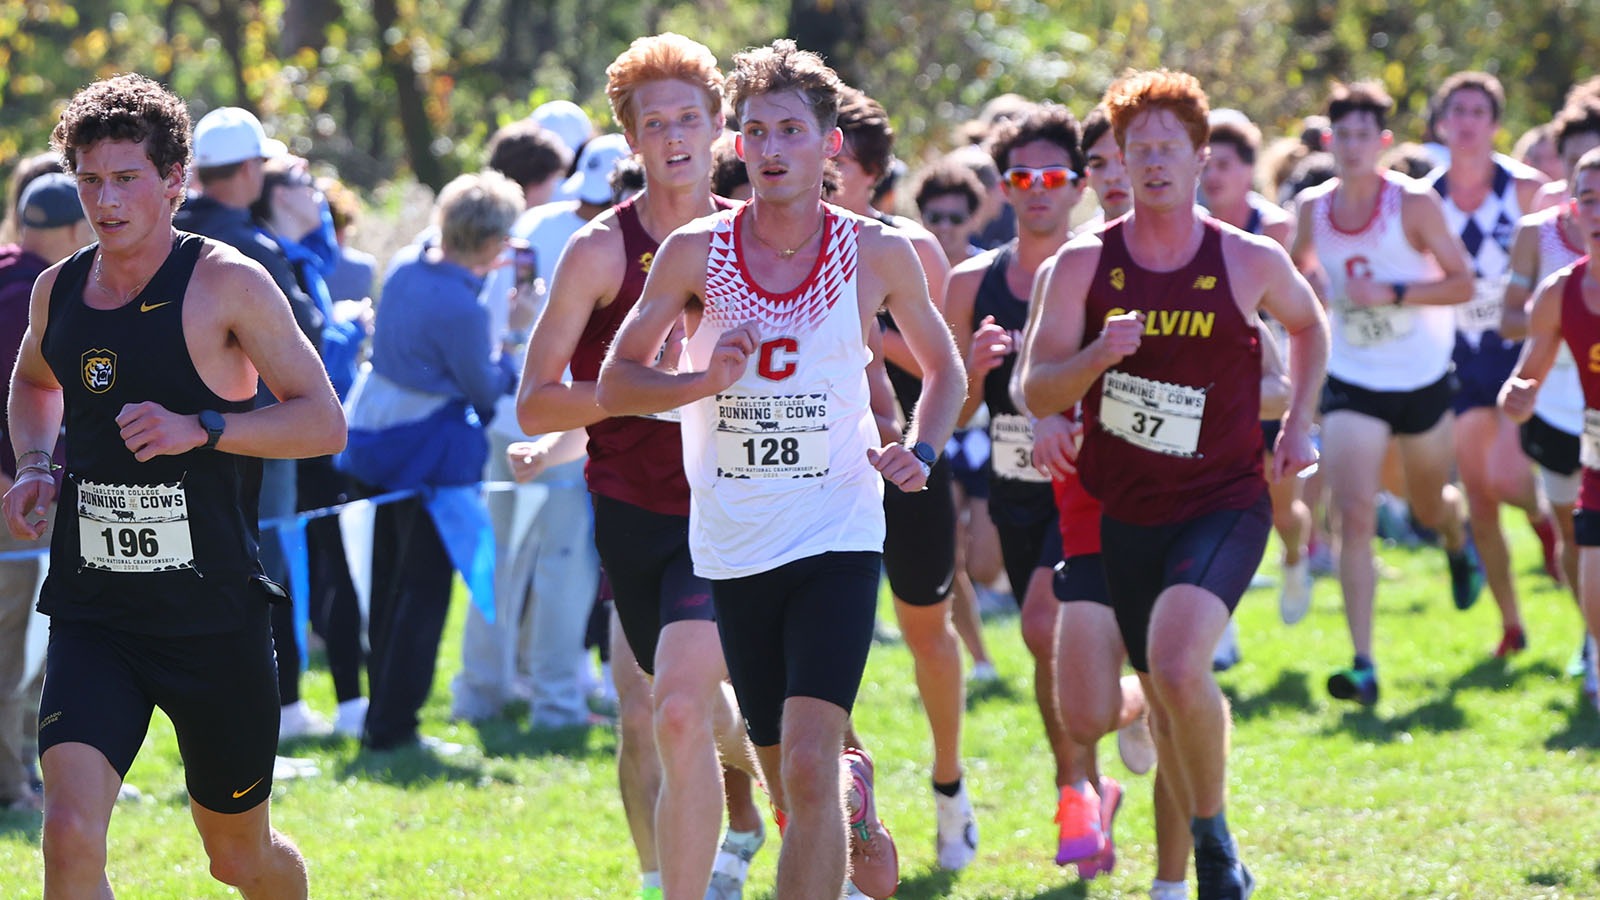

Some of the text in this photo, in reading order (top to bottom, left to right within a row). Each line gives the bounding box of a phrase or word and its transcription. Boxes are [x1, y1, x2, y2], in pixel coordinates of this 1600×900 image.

[1104, 307, 1215, 338] LVIN
[757, 336, 798, 382] C
[1108, 377, 1156, 399] RUNNING
[1167, 392, 1203, 408] COWS
[719, 405, 826, 419] RUNNING COWS
[1131, 411, 1165, 438] 37
[743, 437, 800, 466] 128
[1015, 447, 1035, 468] 3
[773, 465, 814, 473] CHAMPIONSHIP
[81, 490, 184, 509] RUNNING COWS
[92, 487, 160, 496] CARLETON COLLEGE
[101, 527, 159, 557] 196
[96, 556, 175, 565] PRE-NATIONAL CHAMPIONSHIP
